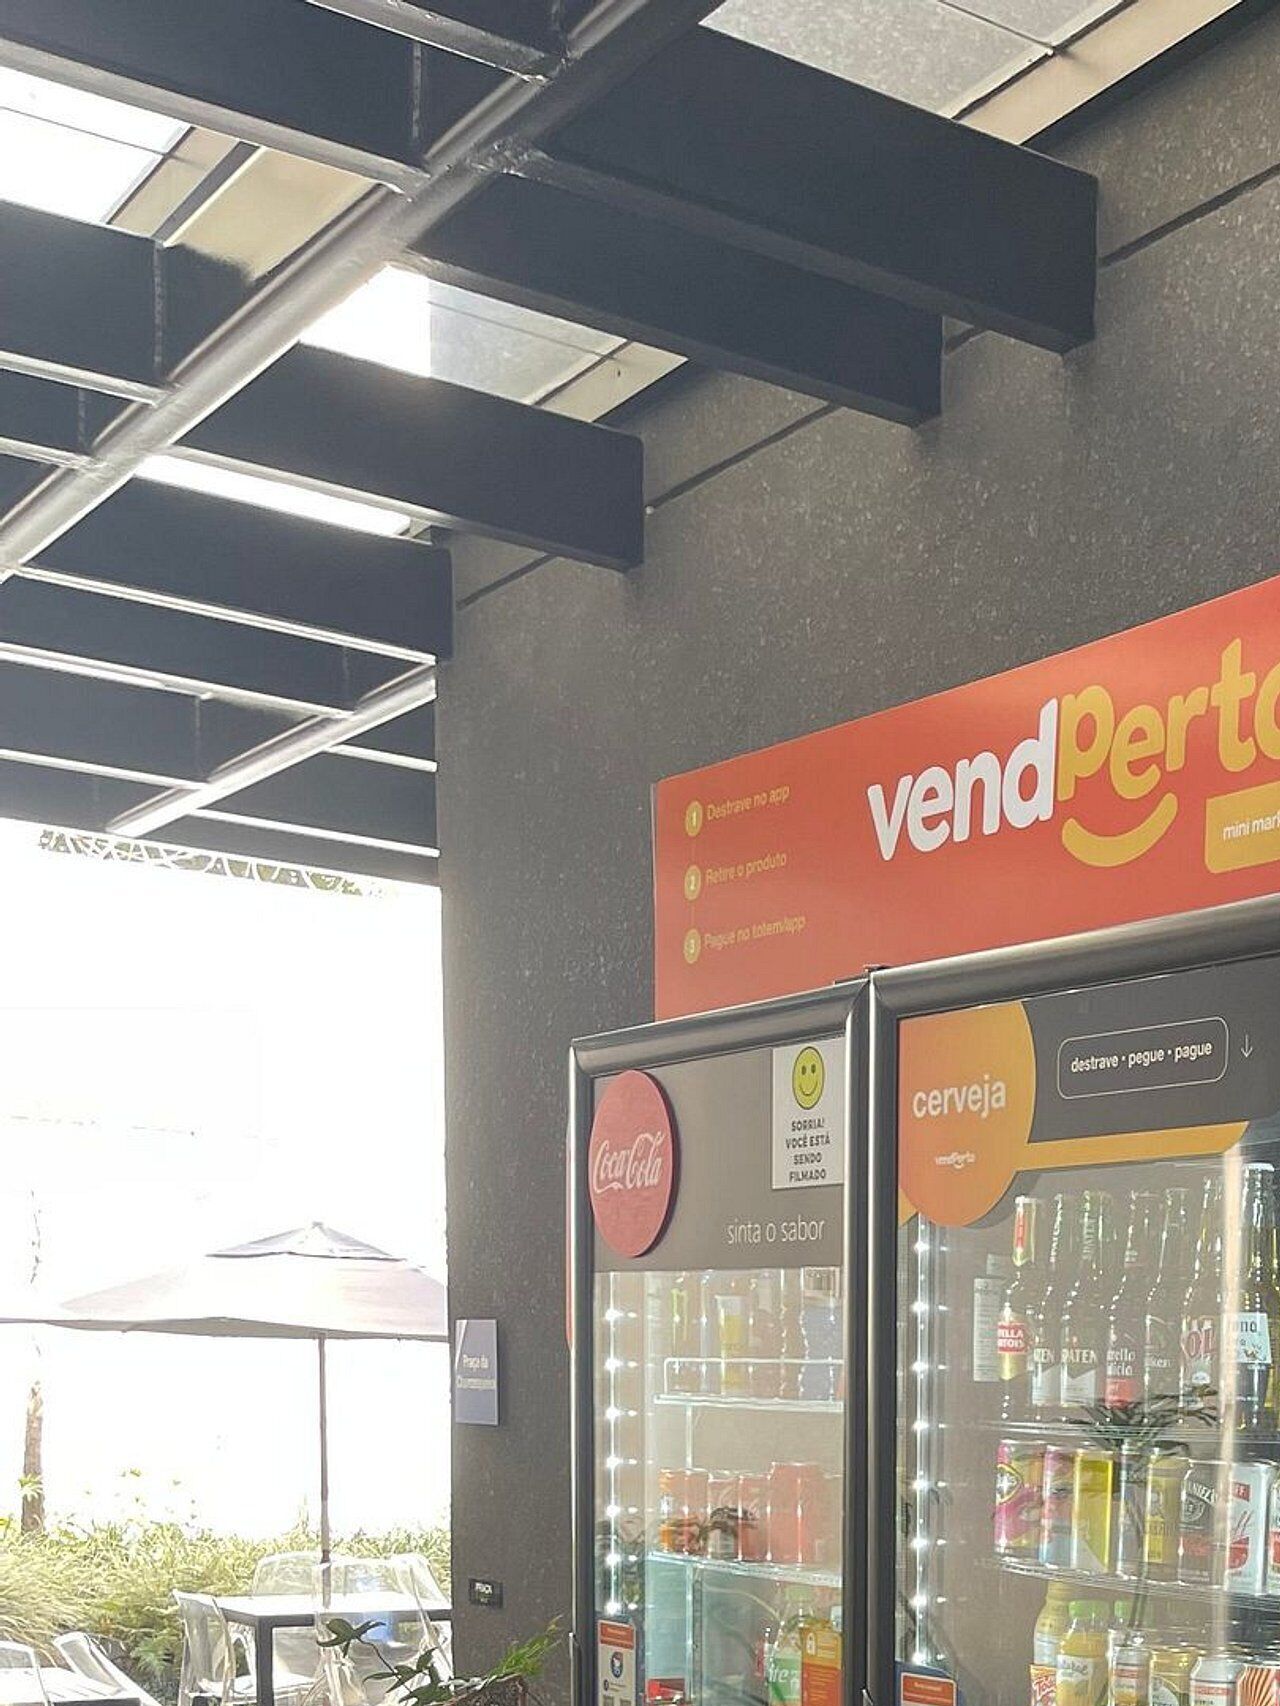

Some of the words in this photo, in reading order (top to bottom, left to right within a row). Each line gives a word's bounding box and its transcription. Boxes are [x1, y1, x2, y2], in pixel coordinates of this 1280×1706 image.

[1223, 819, 1251, 841] mini
[1071, 1053, 1119, 1073] destrave
[1128, 1048, 1164, 1068] pegue
[1174, 1042, 1213, 1062] pague
[913, 1074, 1006, 1119] cerveja
[791, 1117, 825, 1132] SORRIA!
[785, 1133, 808, 1149] VOCÊ
[809, 1131, 830, 1147] ESTÁ
[793, 1152, 822, 1165] SENDO
[789, 1168, 827, 1183] FILMADO
[726, 1217, 761, 1244] sinta
[765, 1222, 776, 1242] o
[781, 1213, 825, 1242] sabor
